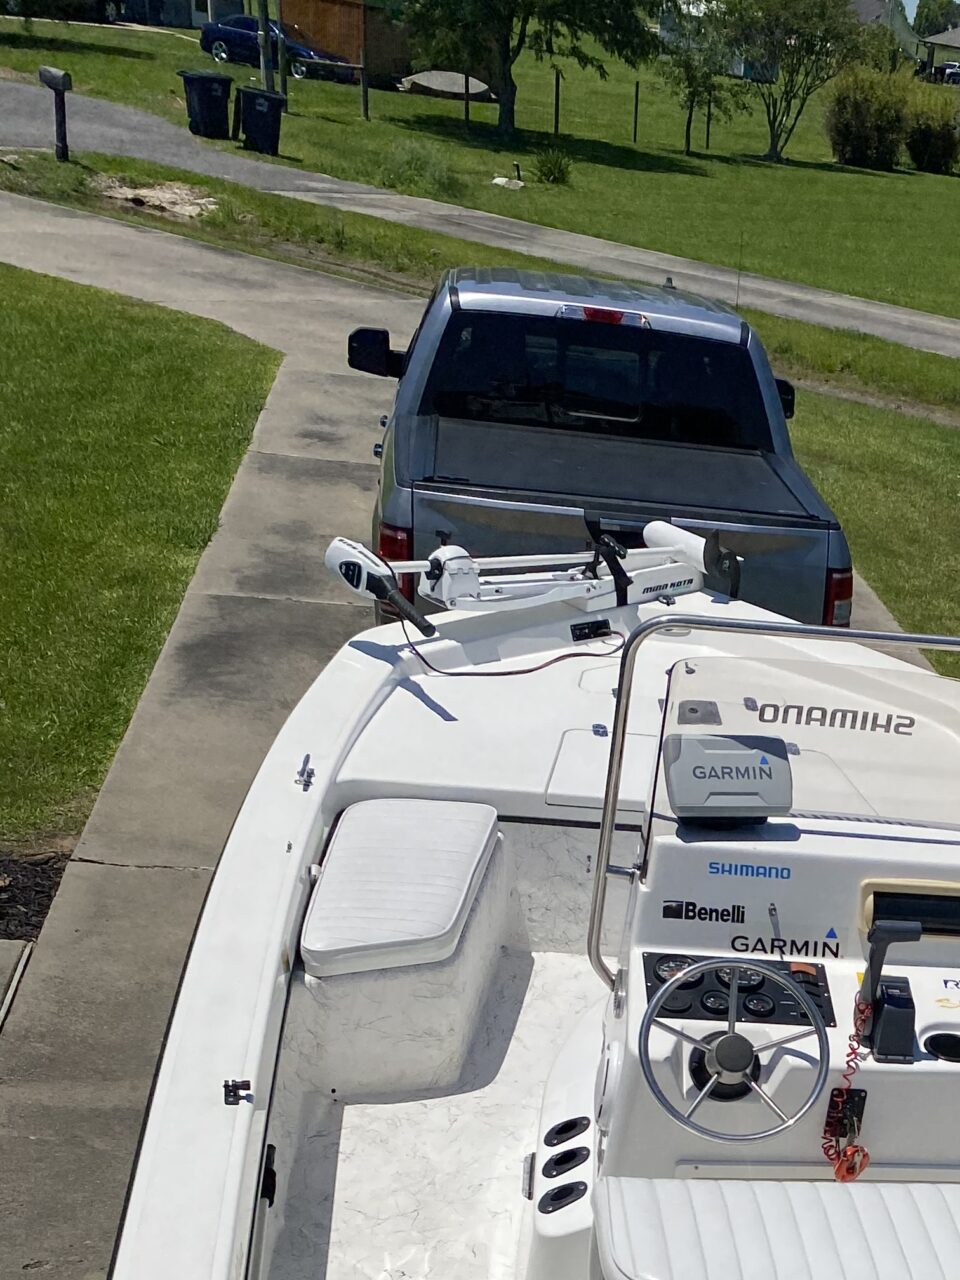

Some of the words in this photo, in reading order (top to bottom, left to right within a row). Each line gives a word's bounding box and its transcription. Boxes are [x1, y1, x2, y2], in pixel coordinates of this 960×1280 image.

[669, 578, 694, 589] KOTA
[692, 765, 773, 780] GARMIN
[708, 862, 791, 880] SHIMANO
[684, 901, 745, 924] Benelli
[731, 935, 840, 959] GARMIN
